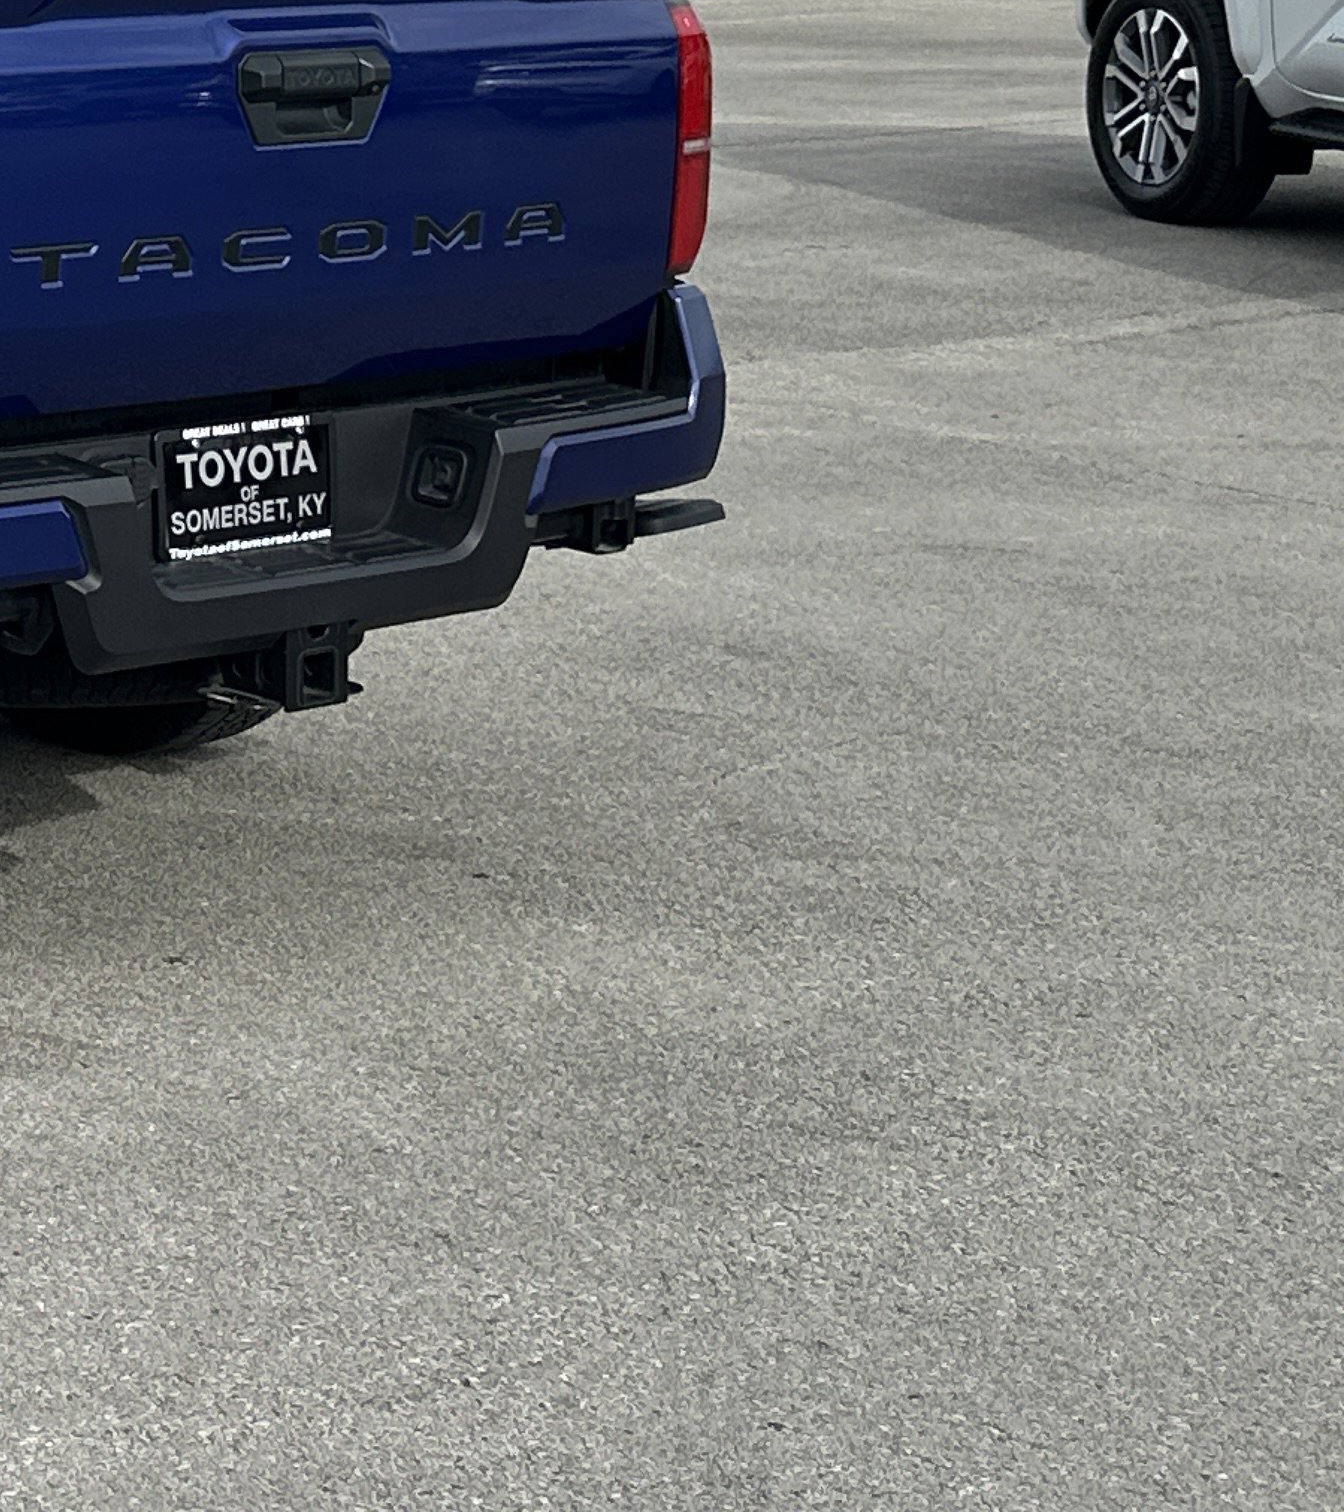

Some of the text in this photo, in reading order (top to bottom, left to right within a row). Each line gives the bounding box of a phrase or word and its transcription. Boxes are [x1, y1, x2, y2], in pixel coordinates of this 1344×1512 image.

[10, 202, 566, 289] TACOMA
[176, 439, 318, 489] TOYOTA
[170, 491, 327, 535] SOMERSET, KY
[240, 484, 260, 502] OF
